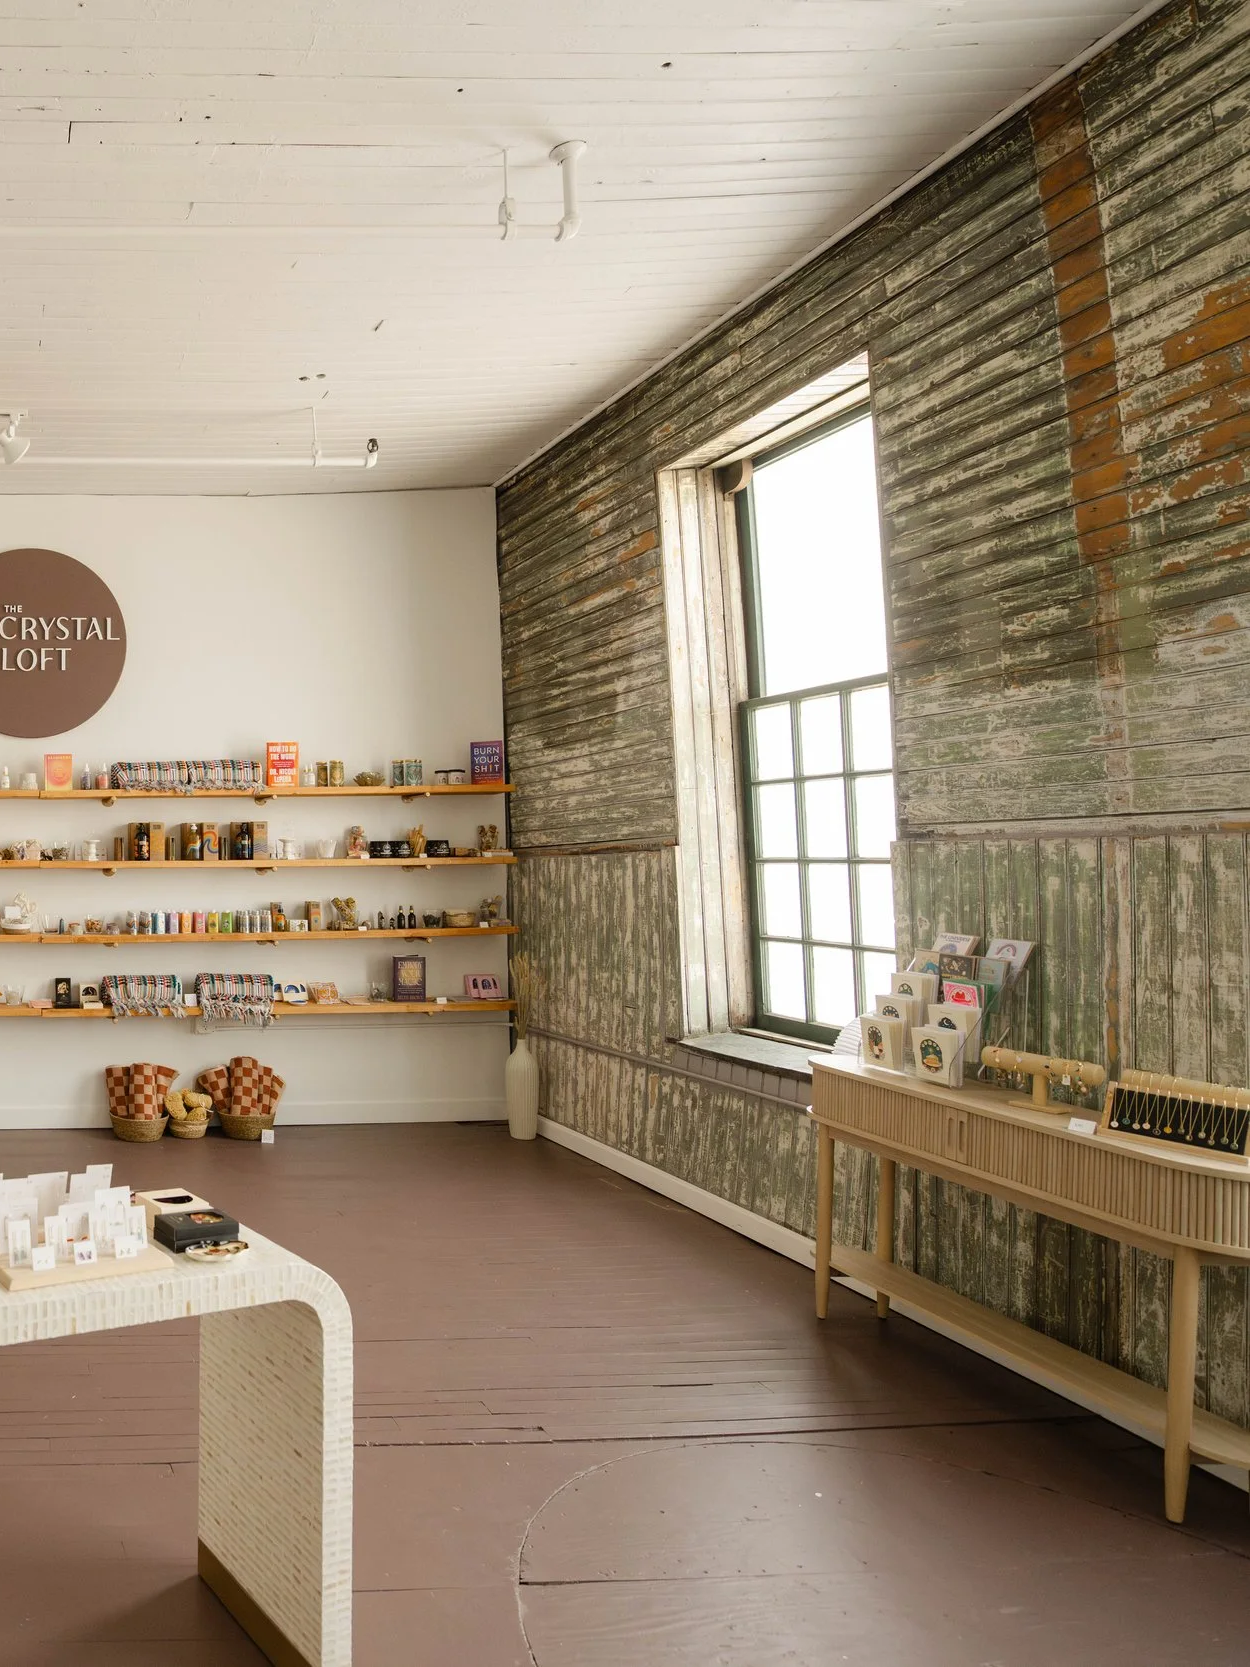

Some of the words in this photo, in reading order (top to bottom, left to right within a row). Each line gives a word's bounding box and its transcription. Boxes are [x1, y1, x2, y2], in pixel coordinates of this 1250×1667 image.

[4, 605, 23, 613] THE
[1, 647, 72, 672] LOFT
[269, 745, 281, 753] HOW
[282, 745, 289, 753] TO
[473, 746, 500, 755] BURN
[473, 755, 500, 764] YOUR
[474, 764, 500, 773] SHIT
